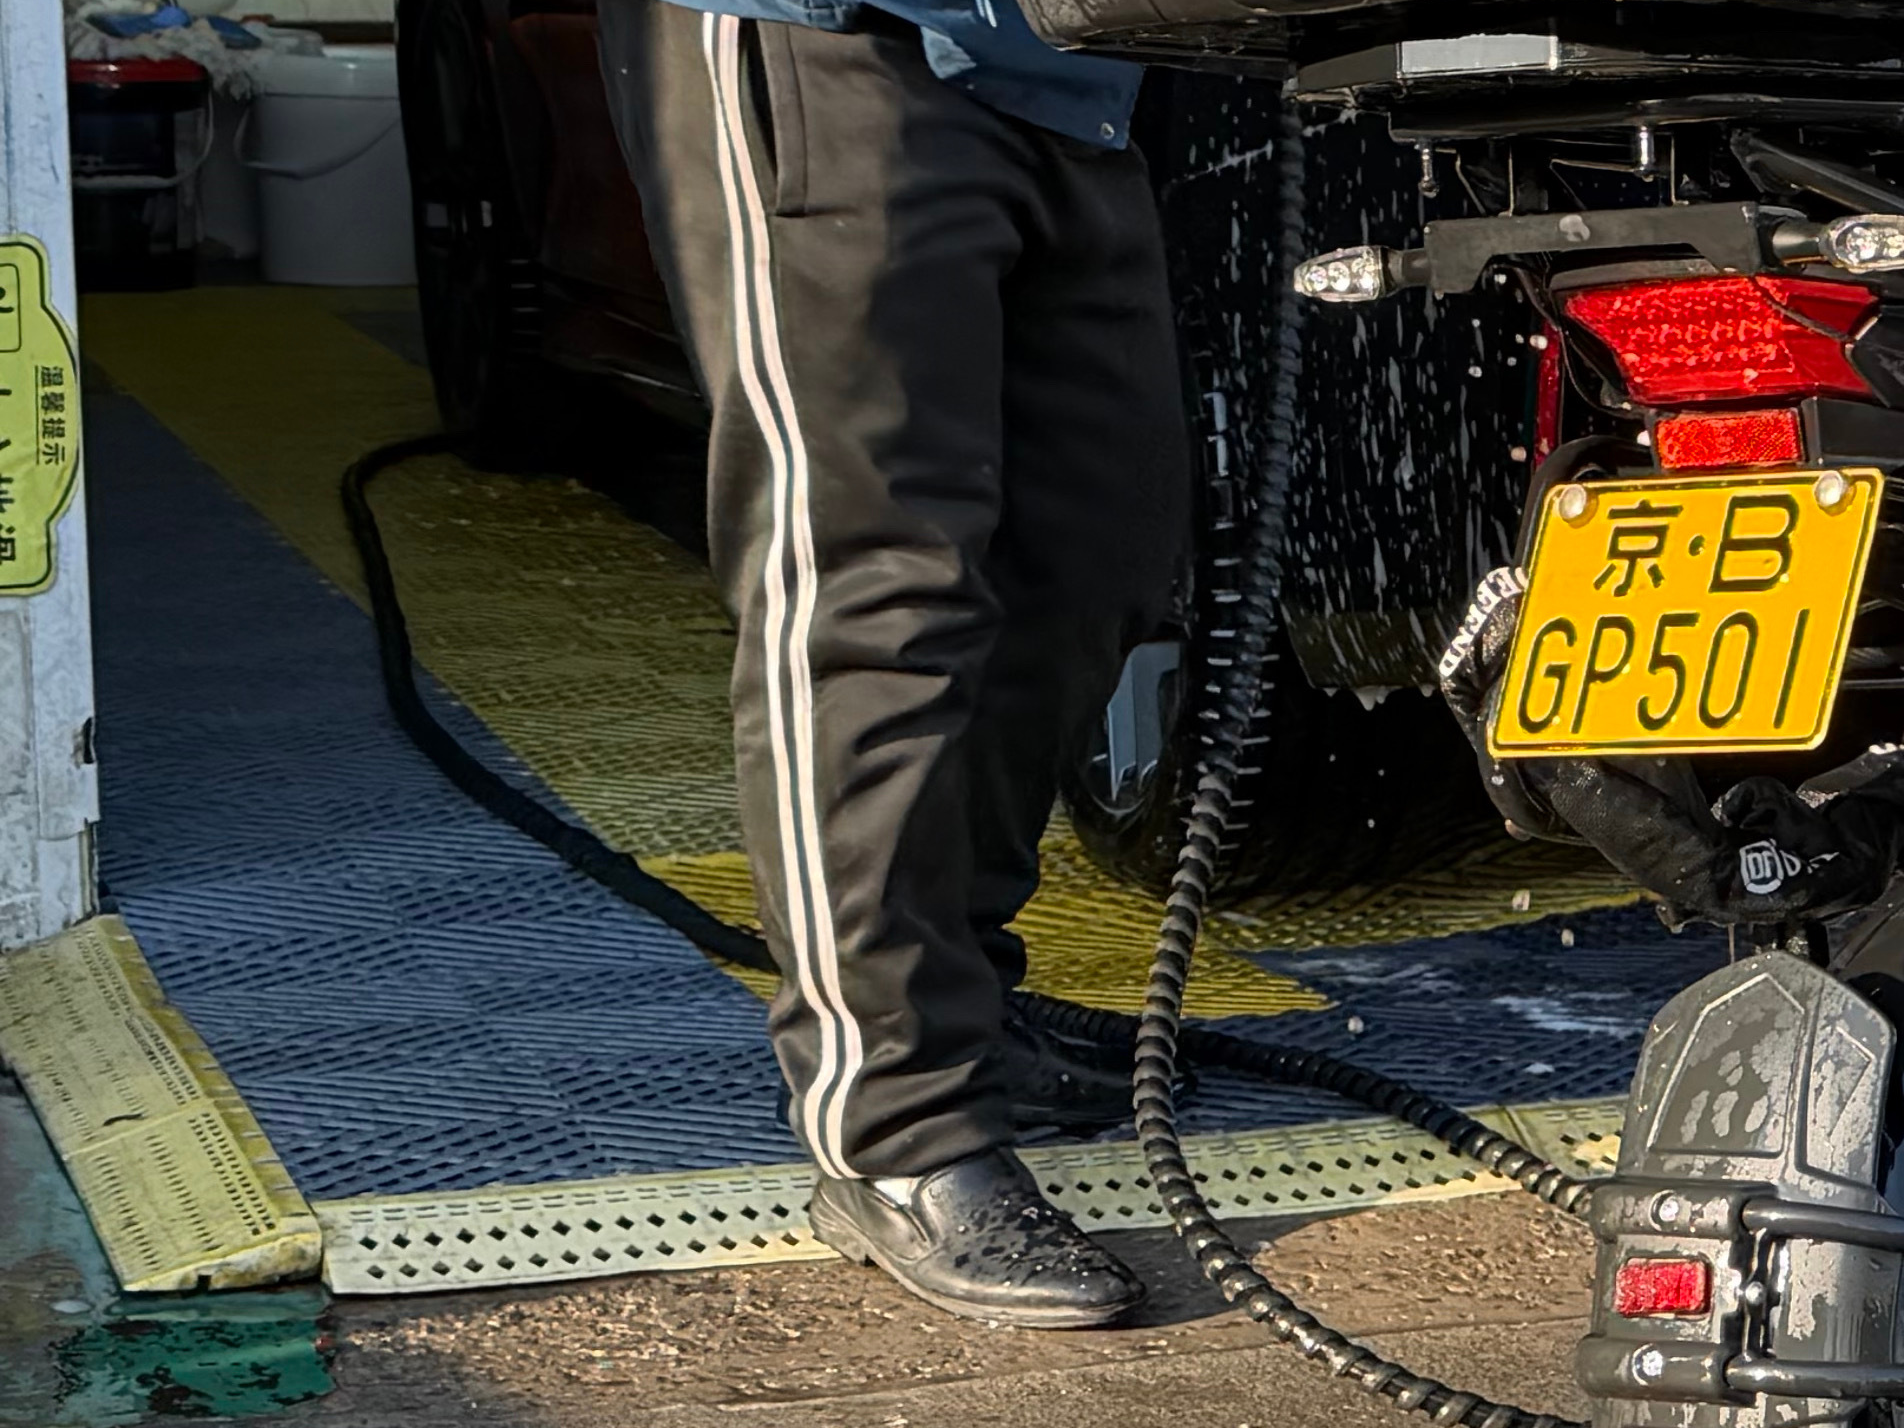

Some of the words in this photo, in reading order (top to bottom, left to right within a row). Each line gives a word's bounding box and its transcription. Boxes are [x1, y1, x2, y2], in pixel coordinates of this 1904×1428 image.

[40, 365, 66, 466] 温馨提示
[1517, 608, 1810, 734] GP501
